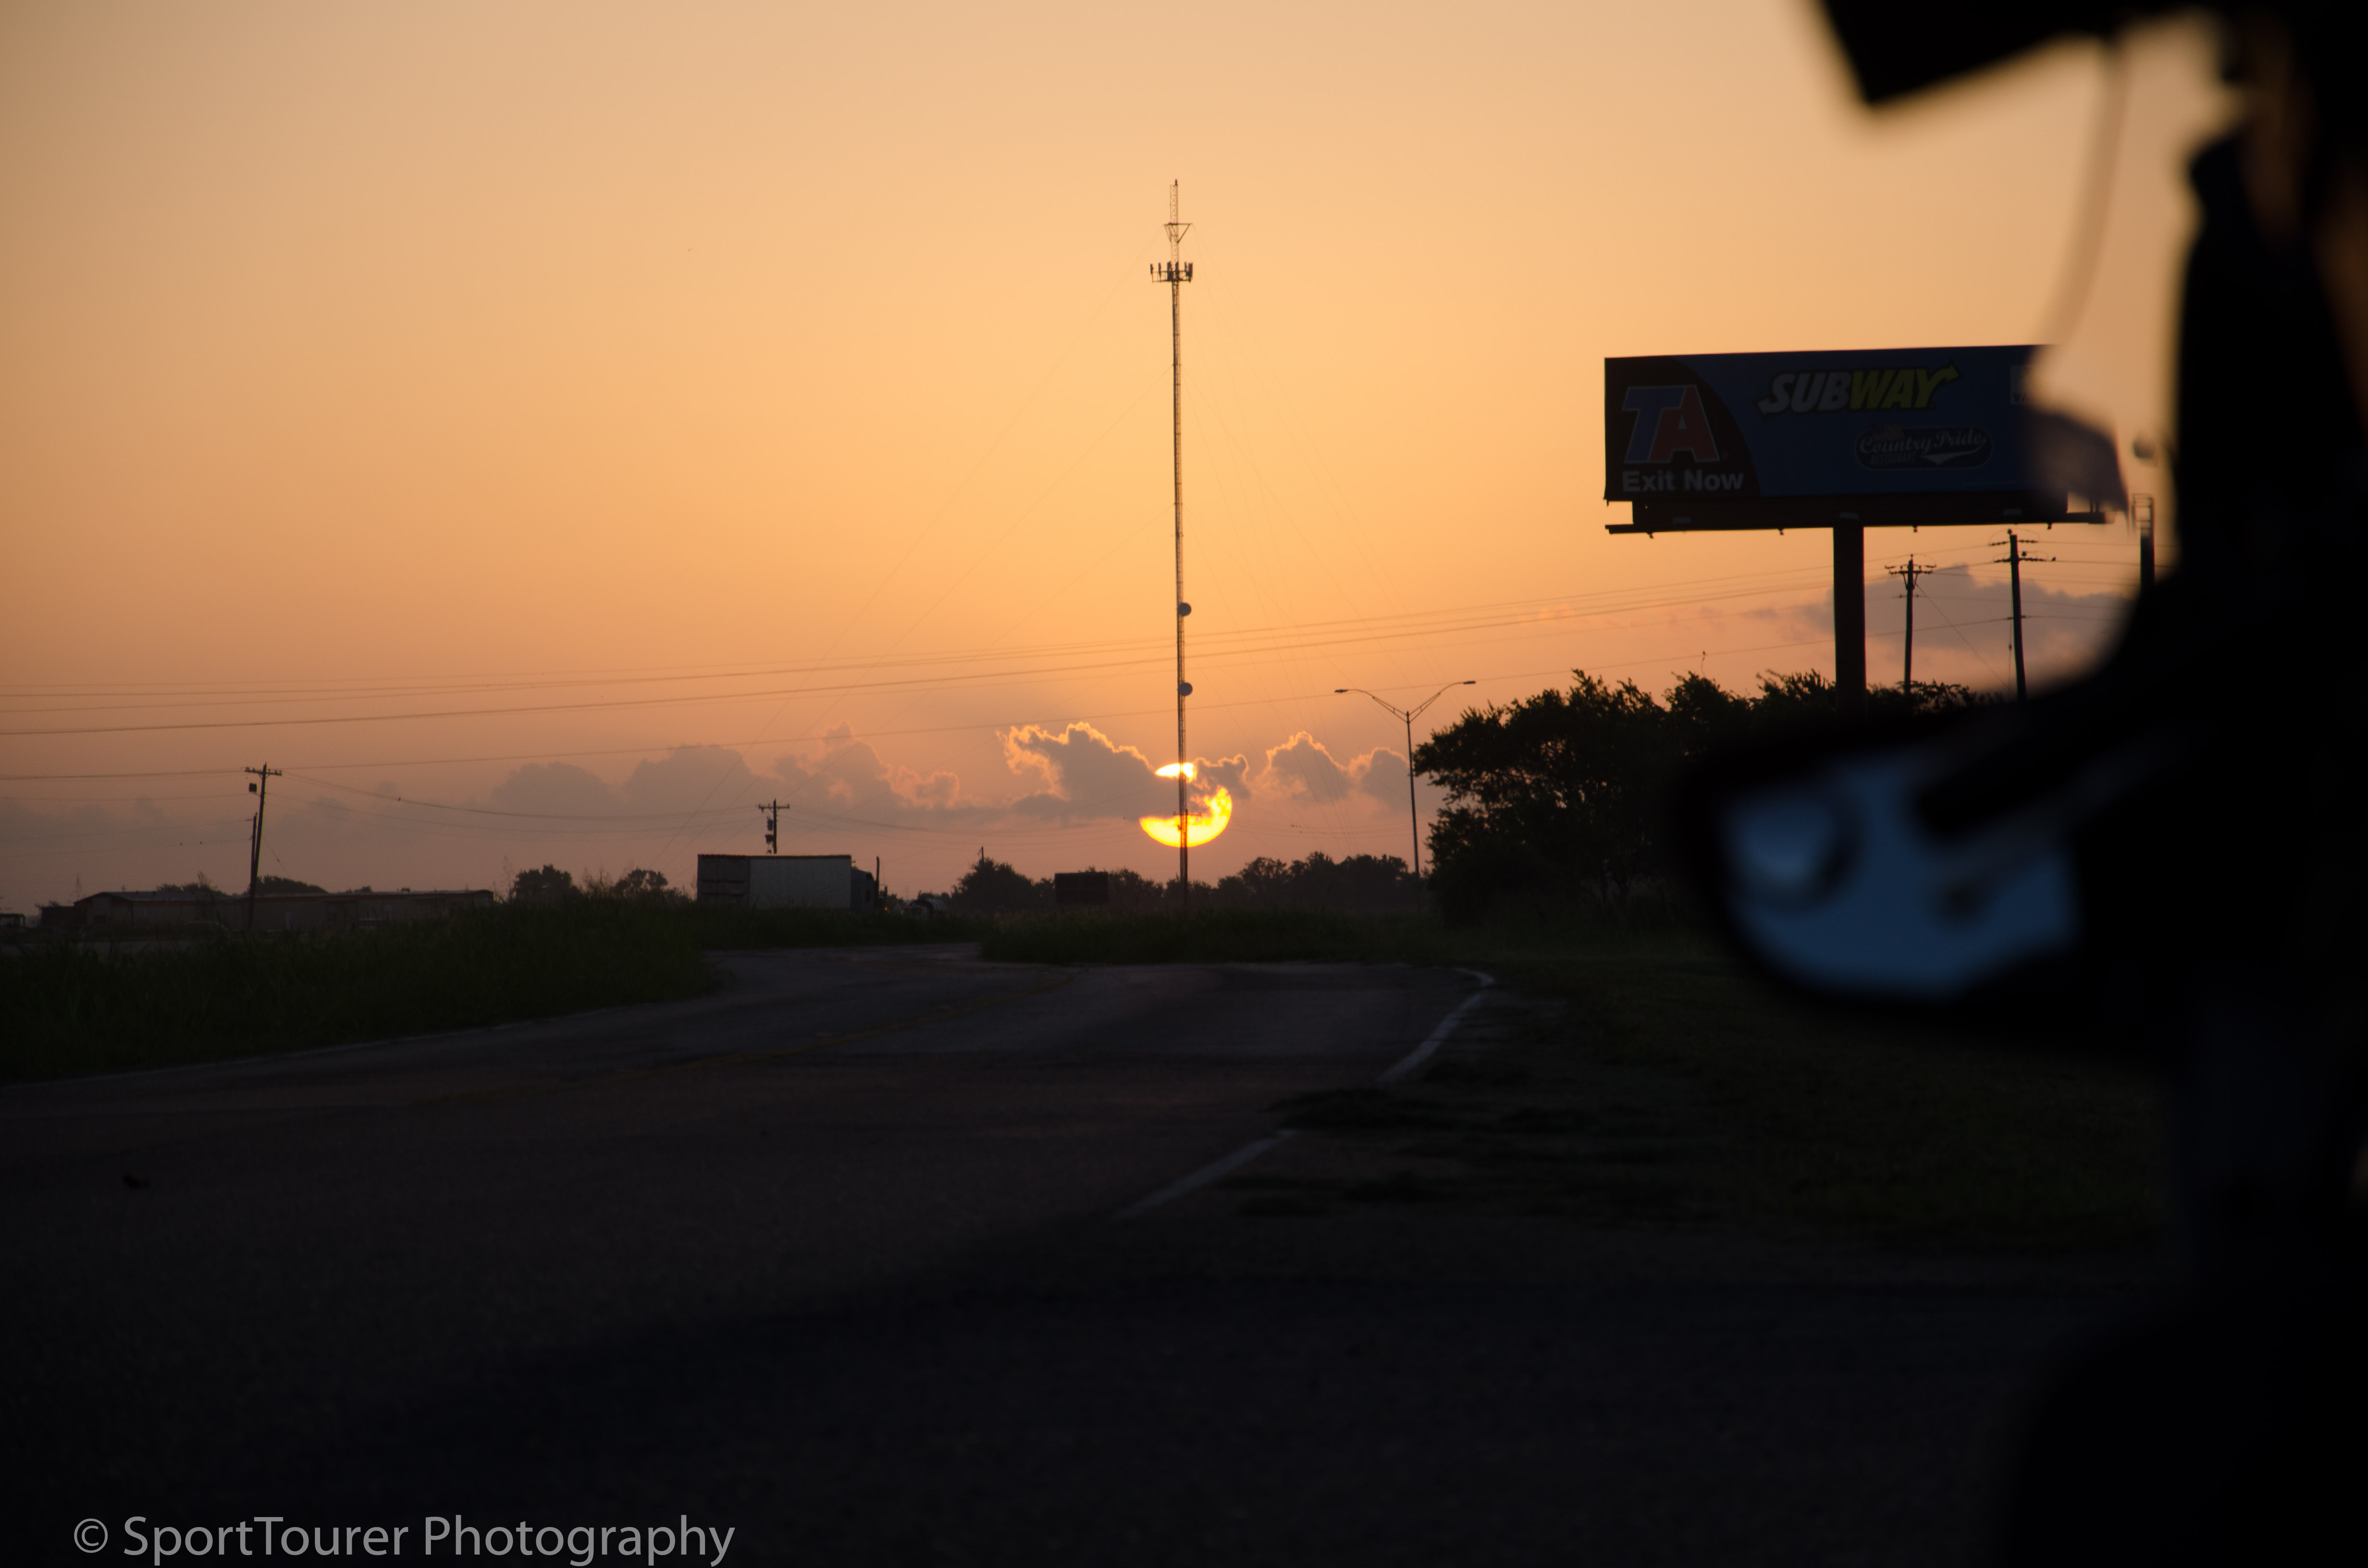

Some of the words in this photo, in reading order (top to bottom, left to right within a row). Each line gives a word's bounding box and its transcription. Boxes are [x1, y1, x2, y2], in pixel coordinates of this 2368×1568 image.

[1755, 363, 1961, 416] SUBWAY
[1622, 384, 1720, 464] TA
[1860, 436, 1932, 454] Country
[1934, 429, 1987, 447] Pride
[1622, 470, 1676, 492] Exit
[1683, 469, 1744, 492] Now
